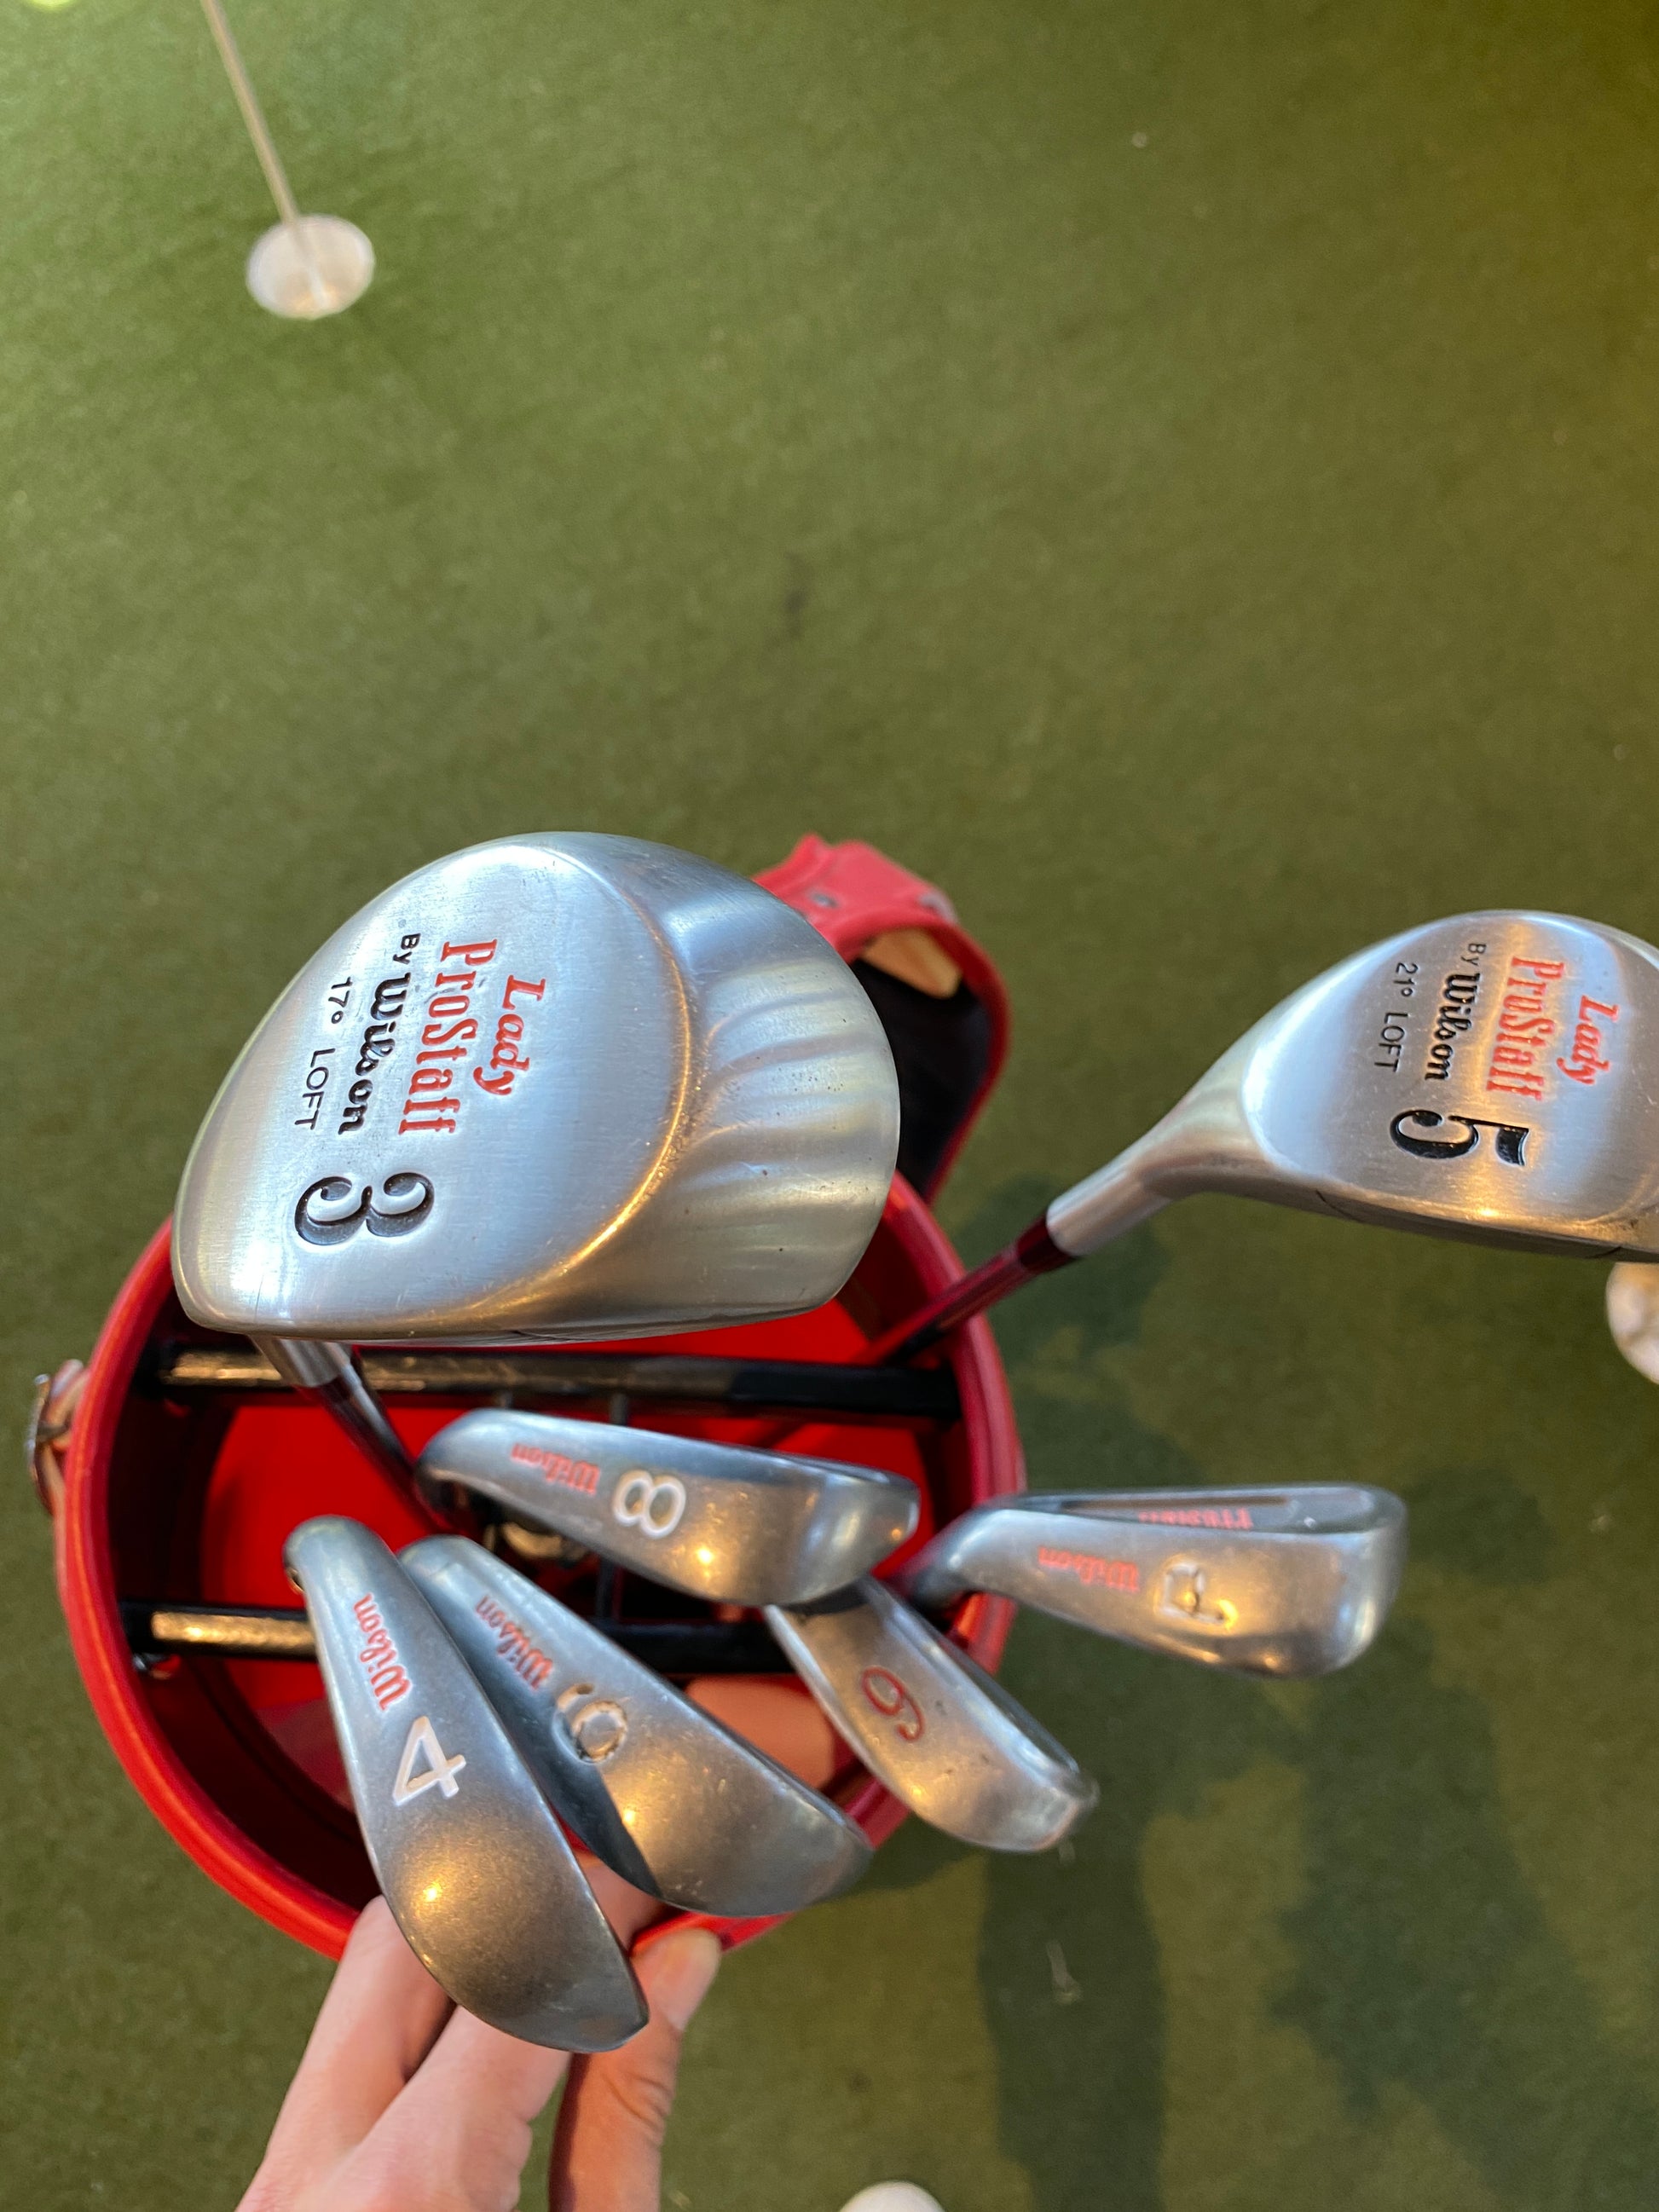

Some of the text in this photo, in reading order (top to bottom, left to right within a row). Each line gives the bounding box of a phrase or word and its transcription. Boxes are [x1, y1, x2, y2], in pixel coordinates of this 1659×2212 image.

[338, 933, 421, 1135] By Wilson
[398, 939, 498, 1135] ProStaff
[473, 974, 546, 1096] Lady
[1373, 1012, 1409, 1073] LOFT
[1424, 942, 1487, 1081] By Wilson
[1486, 956, 1565, 1100] ProStaff
[1556, 995, 1620, 1086] Lady
[294, 1047, 336, 1130] LOFT
[1390, 1109, 1529, 1167] 5
[294, 1171, 435, 1246] 3
[510, 1442, 600, 1495] Wilson
[612, 1470, 686, 1539] 8
[1038, 1545, 1140, 1593] Wilson
[353, 1591, 413, 1712] Wilson
[476, 1596, 553, 1690] Wilson
[392, 1715, 467, 1807] 4
